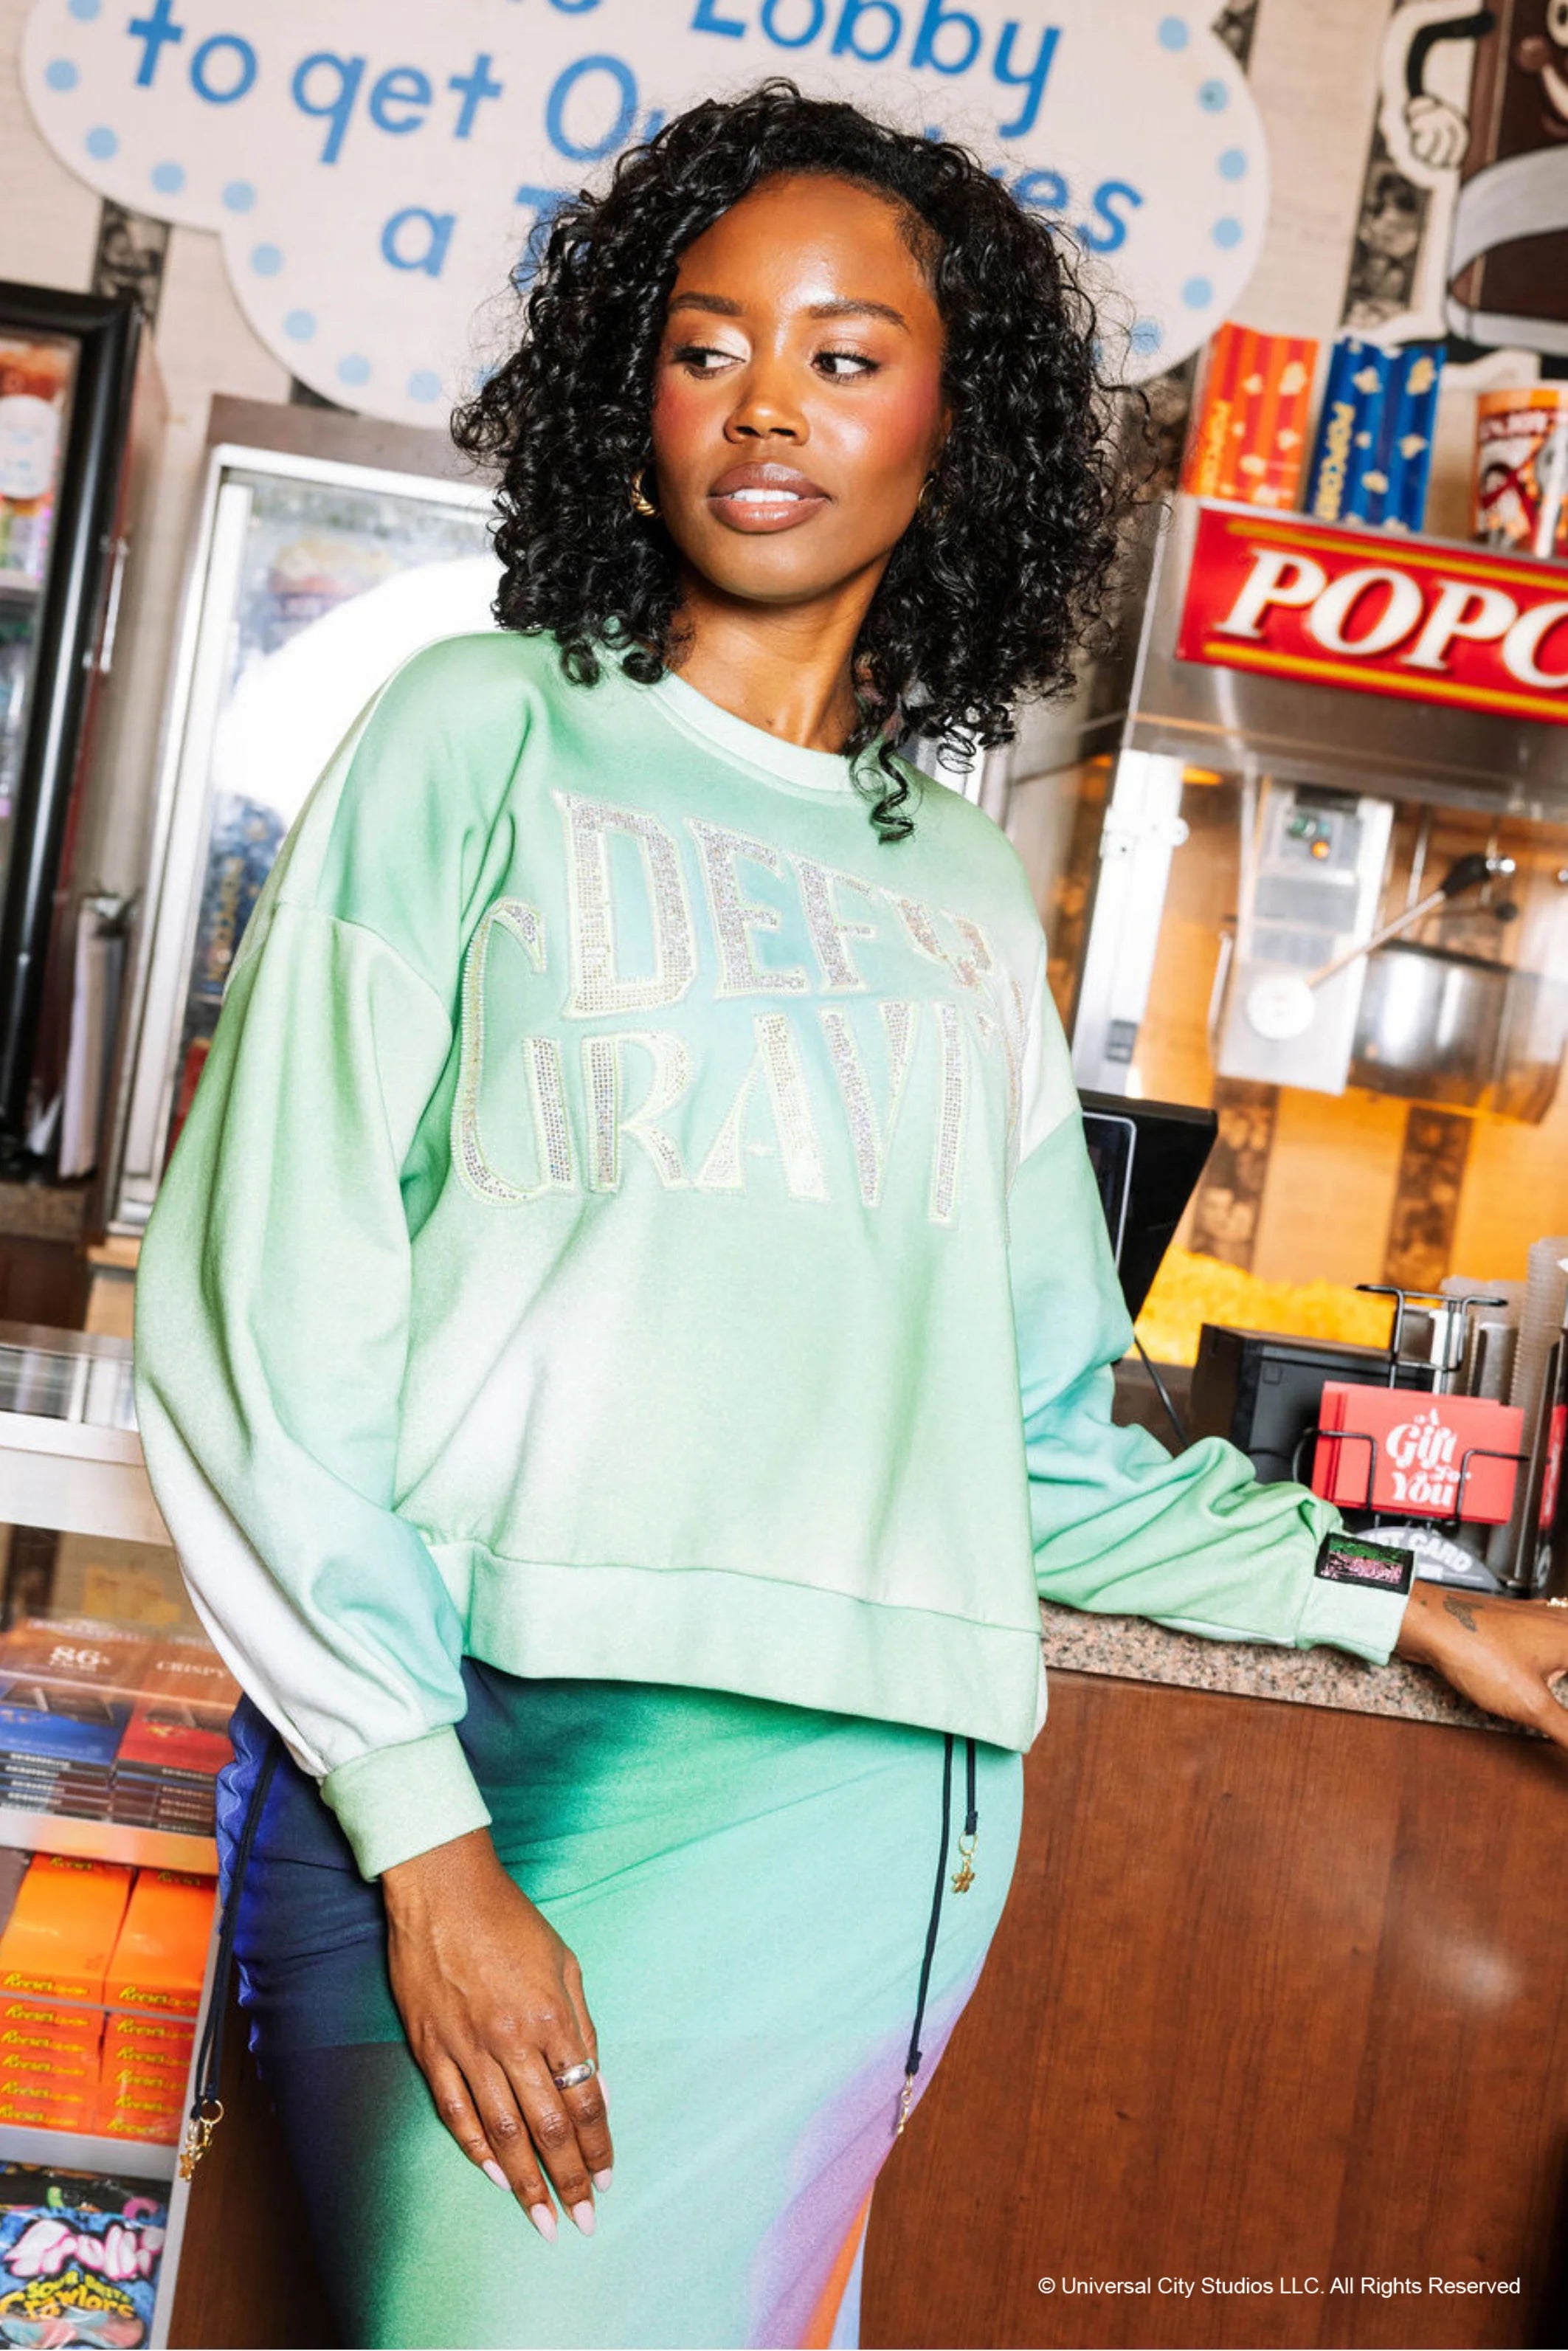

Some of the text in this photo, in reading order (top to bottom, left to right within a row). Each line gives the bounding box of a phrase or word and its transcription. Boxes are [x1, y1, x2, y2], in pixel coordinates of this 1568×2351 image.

[128, 0, 257, 104] to
[381, 207, 456, 277] a
[1313, 401, 1355, 521] POPCORN
[1385, 1423, 1459, 1469] Gift
[1391, 1470, 1454, 1508] You
